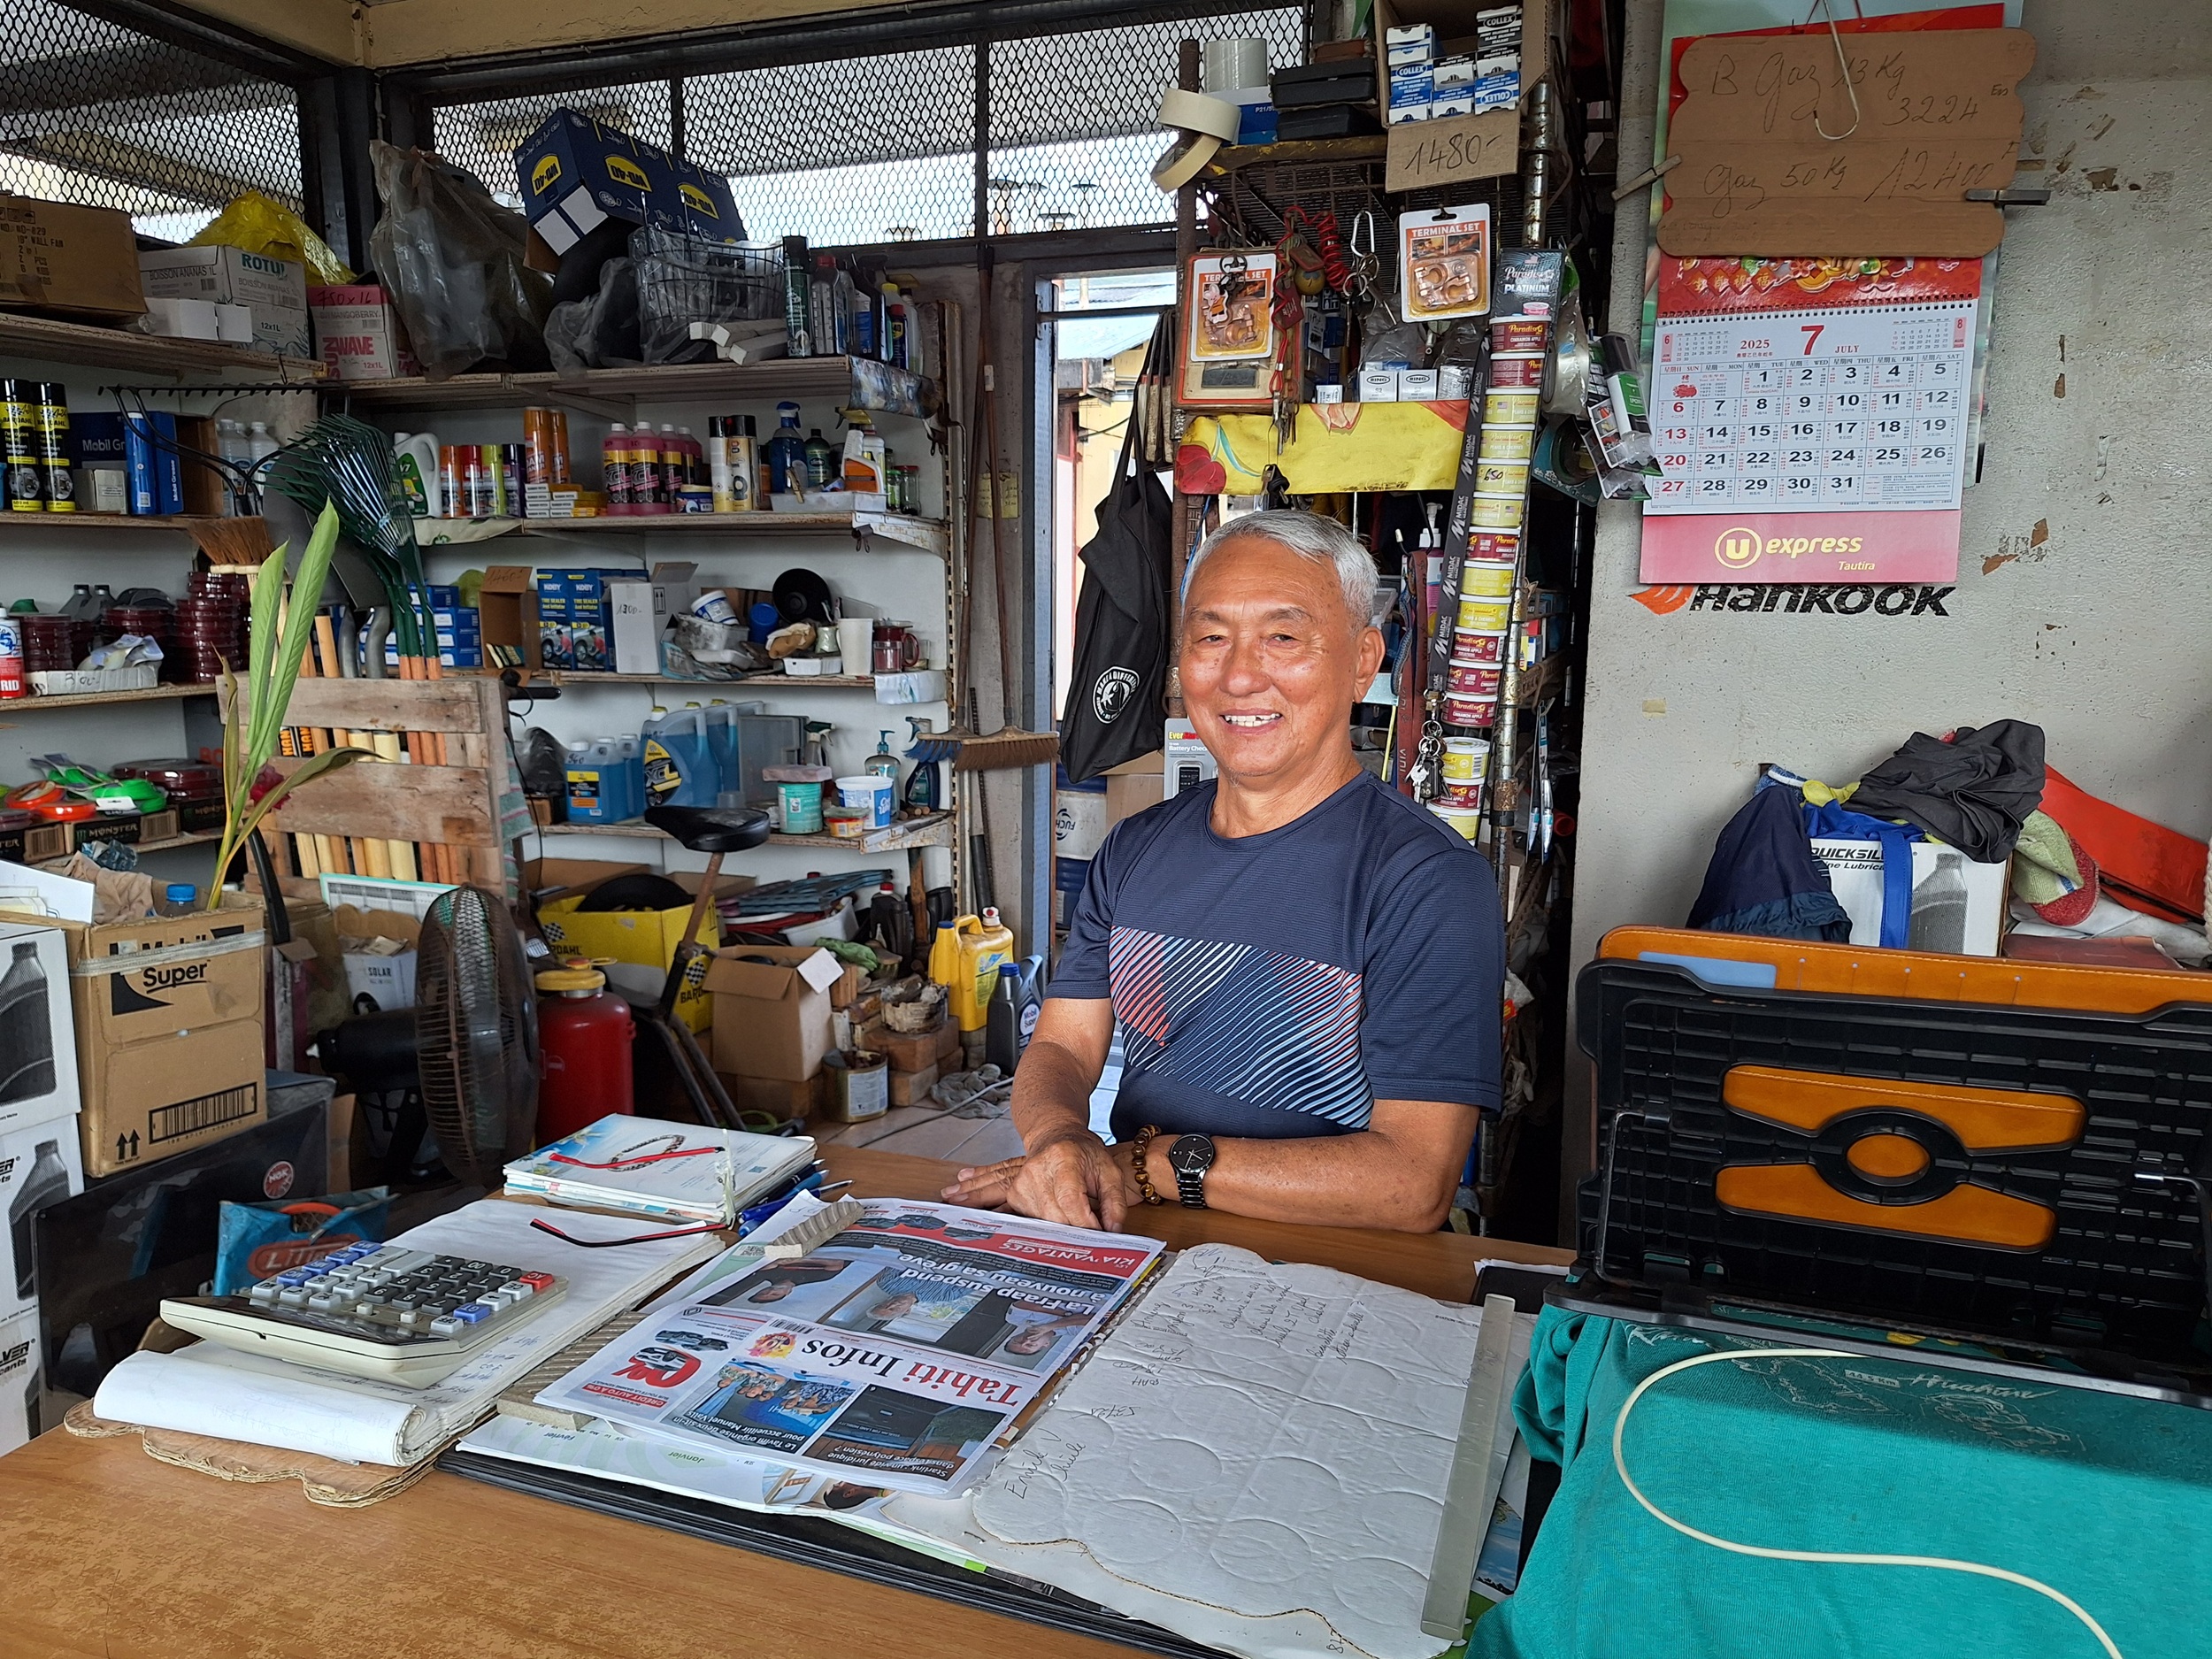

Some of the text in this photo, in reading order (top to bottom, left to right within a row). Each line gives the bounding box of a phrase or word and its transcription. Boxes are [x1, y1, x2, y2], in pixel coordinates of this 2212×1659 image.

[1486, 16, 1513, 27] COLLEX
[1399, 65, 1425, 76] COLLEX
[1712, 54, 1738, 95] B
[1876, 51, 1905, 99] Kg
[1485, 92, 1509, 102] COLLEX
[1883, 96, 1978, 127] 3224
[534, 163, 559, 191] WD-40
[610, 164, 649, 189] WD-40
[1780, 165, 1818, 188] 50
[685, 194, 716, 215] WD-40
[1411, 222, 1480, 237] TERMINAL SET
[32, 236, 49, 246] WALL
[150, 266, 217, 280] BOISSON ANANAS 1L
[1251, 270, 1266, 280] SET
[238, 277, 290, 295] BOISSON ANANAS
[1504, 284, 1550, 295] PLATINUM
[260, 321, 281, 332] 12x1L
[1740, 339, 1770, 350] 2025
[1801, 325, 1825, 356] 7
[322, 337, 374, 380] SUN WAVE
[1801, 369, 1813, 380] 2
[1846, 367, 1857, 379] 3
[1887, 365, 1901, 377] 4
[1934, 363, 1947, 374] 5
[1759, 371, 1768, 382] 1
[1799, 396, 1810, 408] 9
[1836, 395, 1860, 406] 10
[1882, 393, 1901, 405] 11
[1924, 391, 1949, 403] 12
[1673, 402, 1685, 413] 6
[1714, 400, 1725, 411] 7
[1756, 398, 1767, 410] 8
[1747, 426, 1770, 436] 15
[1791, 424, 1814, 435] 16
[1834, 422, 1858, 434] 17
[1878, 420, 1901, 433] 18
[1923, 419, 1947, 431] 19
[1664, 428, 1686, 440] 13
[1706, 426, 1728, 438] 14
[82, 440, 111, 451] Mobil
[1747, 452, 1770, 464] 22
[1789, 451, 1813, 462] 23
[1831, 449, 1855, 461] 24
[1876, 449, 1901, 460] 25
[1921, 447, 1946, 458] 26
[1663, 455, 1686, 465] 20
[1704, 454, 1725, 465] 21
[1484, 468, 1503, 480] 650
[1662, 480, 1685, 492] 27
[1702, 480, 1725, 491] 28
[1744, 479, 1768, 490] 29
[1787, 478, 1810, 489] 30
[1831, 477, 1853, 488] 31
[1455, 495, 1464, 518] MIDAC
[1765, 535, 1863, 559] express
[1447, 556, 1456, 579] MIDAC
[1838, 561, 1876, 572] Tautira
[1439, 616, 1448, 638] MIDAC
[645, 764, 679, 787] XCL
[88, 823, 138, 839] MONSTER
[142, 963, 207, 988] Super
[368, 966, 392, 977] SOLAR
[267, 1171, 289, 1184] NGK
[898, 1254, 1106, 1304] à nouveau sa grève
[900, 1269, 1095, 1315] La Fraap suspend
[802, 1339, 1023, 1407] Tahiti Infos
[608, 1388, 665, 1407] CRÉDIT AUTO
[672, 1416, 698, 1429] sit-in
[687, 1409, 806, 1443] pour accueillir Manuel Valls
[698, 1422, 719, 1434] deux
[543, 1431, 576, 1441] Février
[718, 1427, 758, 1444] organise
[784, 1441, 797, 1450] Le
[668, 1450, 705, 1465] Janvier
[842, 1446, 894, 1463] polynésien
[827, 1452, 949, 1478] Starlink juridique
[933, 1459, 956, 1470] dans
